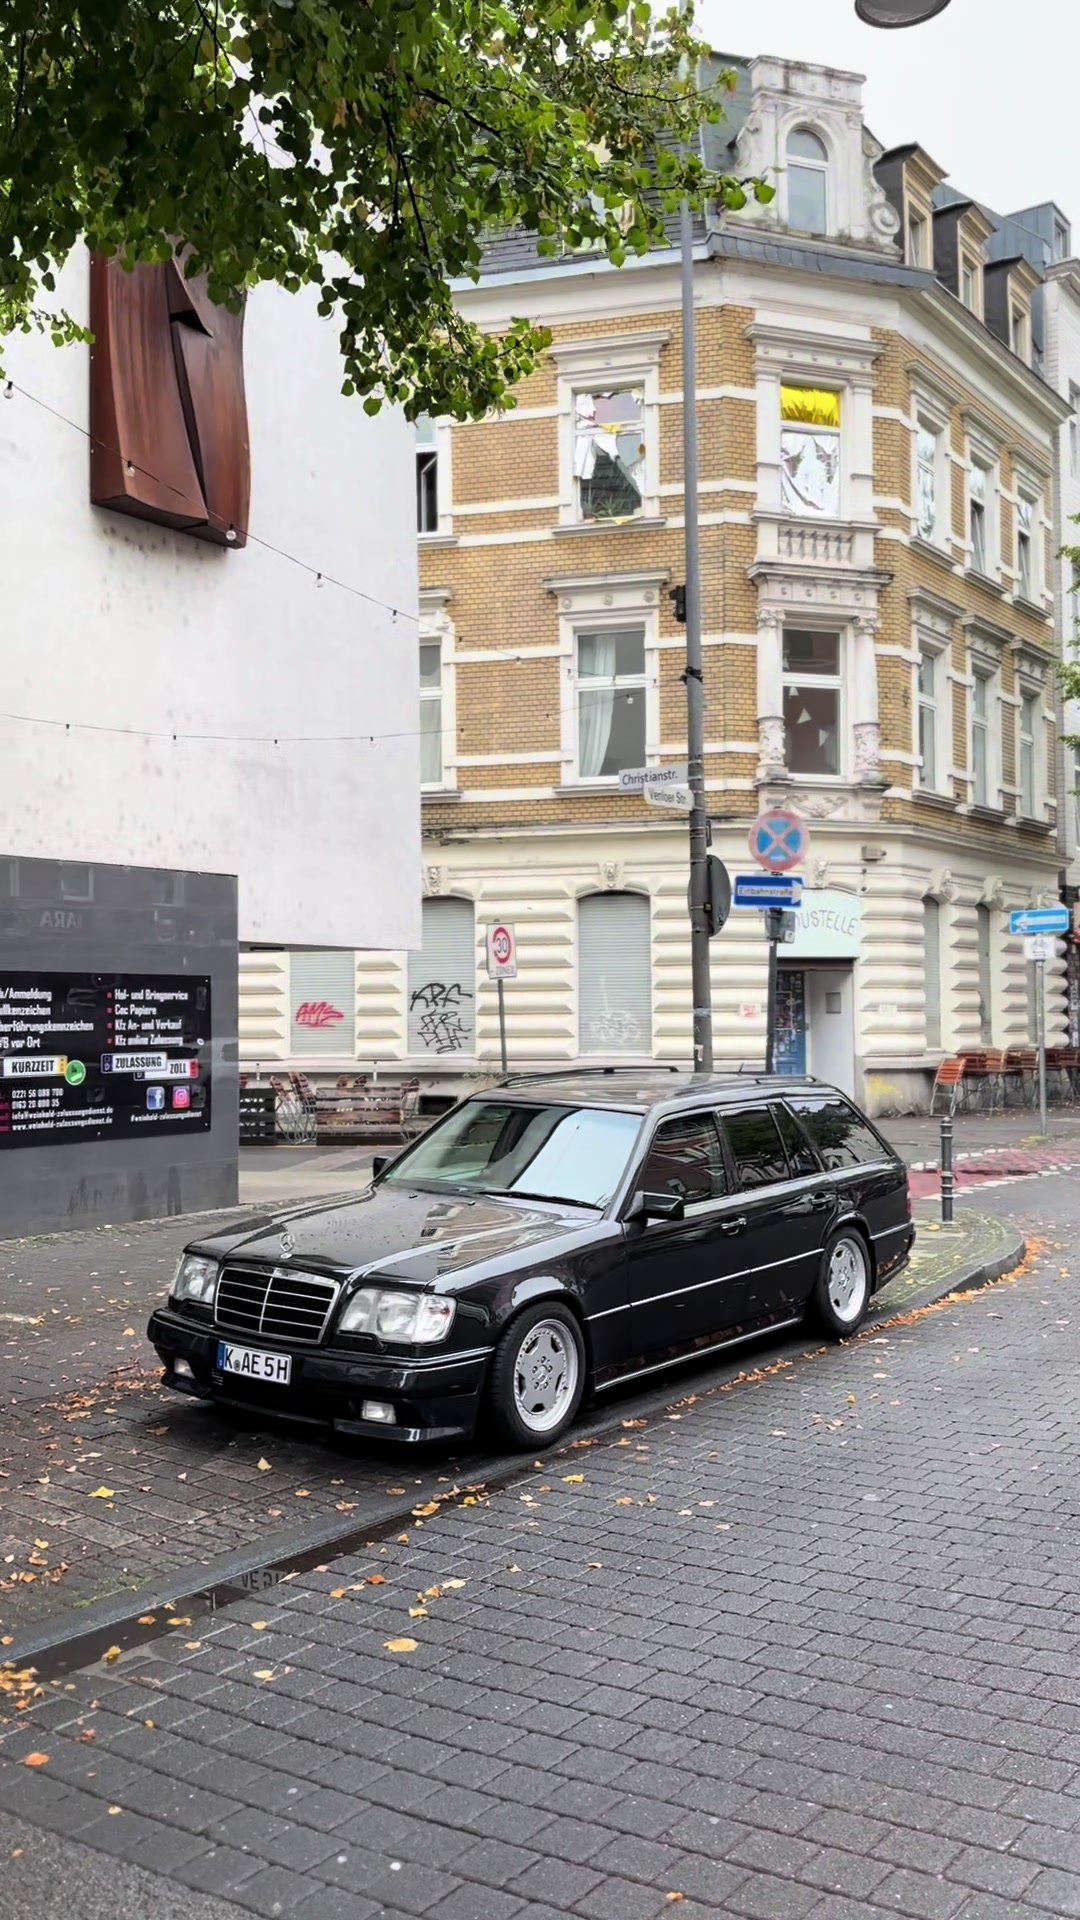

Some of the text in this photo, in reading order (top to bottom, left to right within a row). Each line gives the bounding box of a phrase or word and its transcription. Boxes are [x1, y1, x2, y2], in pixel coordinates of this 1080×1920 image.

[622, 769, 678, 786] Christianstr.
[648, 787, 675, 803] Venloer
[738, 886, 793, 896] Einbahnstraße
[496, 937, 508, 953] 30
[11, 1060, 55, 1073] KURZZEIT
[115, 1056, 162, 1069] ZULASSUNG
[169, 1063, 187, 1075] ZOLL
